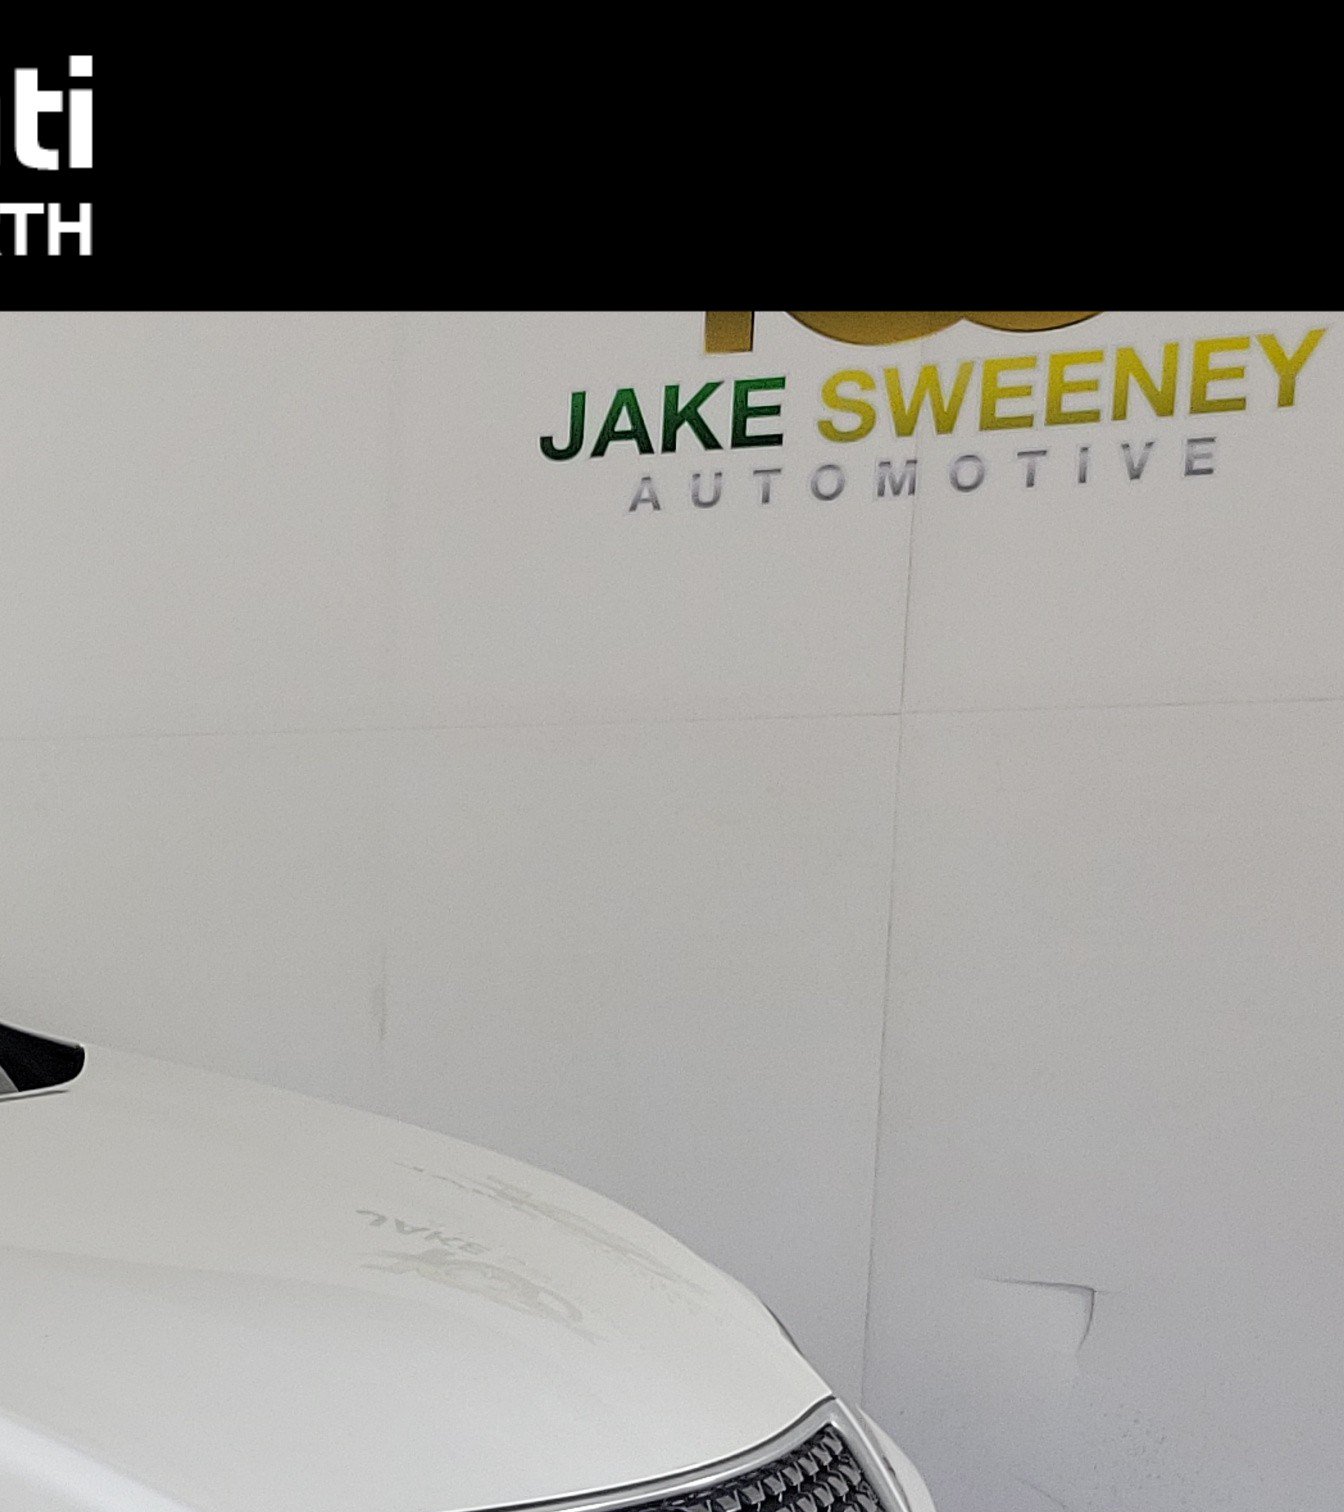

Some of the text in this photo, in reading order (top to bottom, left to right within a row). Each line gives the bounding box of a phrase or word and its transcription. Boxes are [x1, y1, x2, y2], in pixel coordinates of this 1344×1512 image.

[539, 376, 787, 462] JAKE
[817, 328, 1328, 444] SWEENEY
[628, 436, 1219, 514] AUTOMOTIVE
